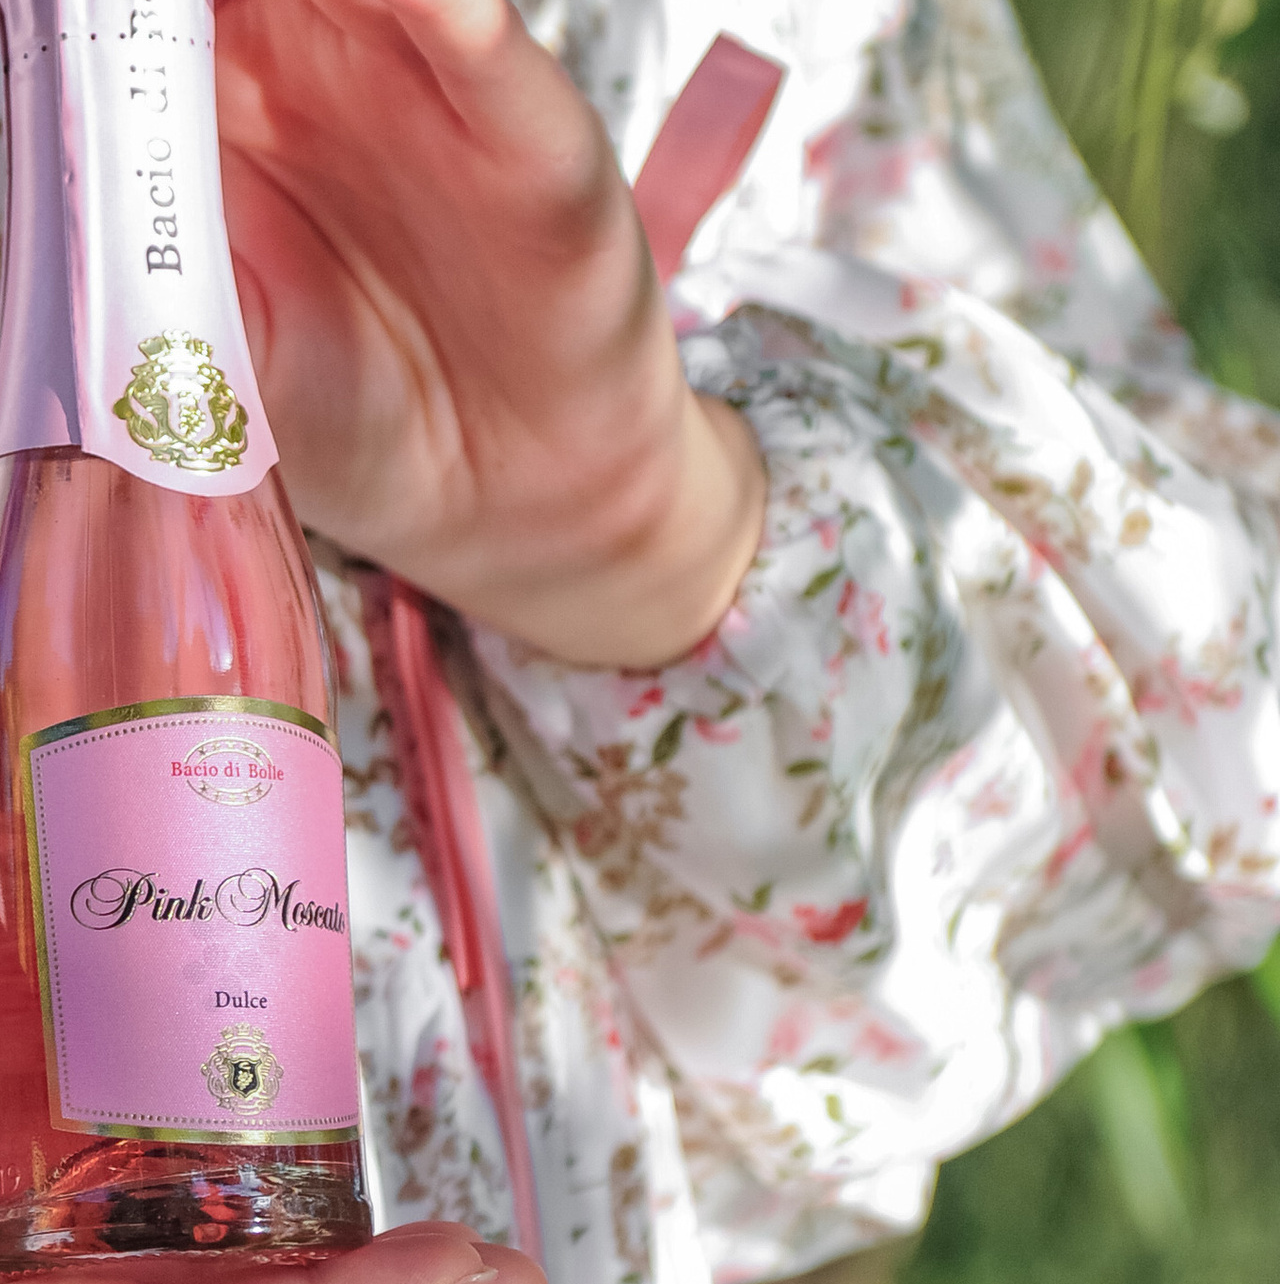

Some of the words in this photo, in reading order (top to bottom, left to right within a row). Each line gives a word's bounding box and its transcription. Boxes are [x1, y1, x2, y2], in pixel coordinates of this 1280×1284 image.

[136, 136, 183, 276] Bacio
[171, 761, 219, 777] Bacio
[224, 761, 240, 777] di
[249, 763, 285, 781] Bolle
[70, 867, 216, 931] Pink
[215, 990, 269, 1010] Dulce
